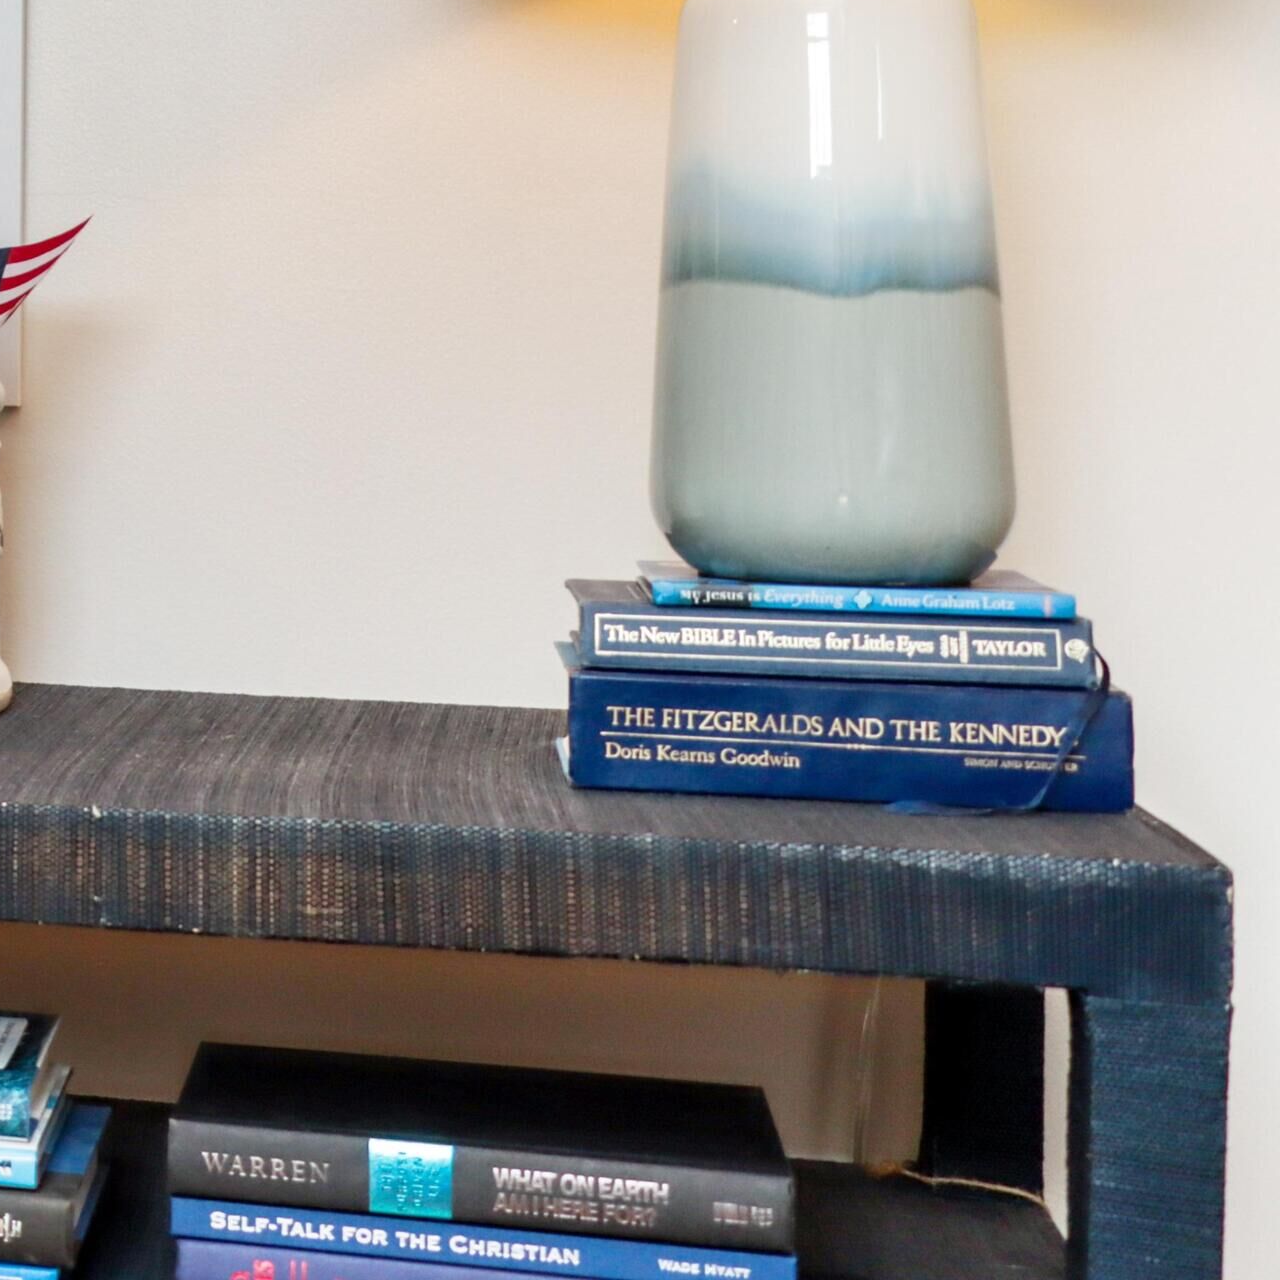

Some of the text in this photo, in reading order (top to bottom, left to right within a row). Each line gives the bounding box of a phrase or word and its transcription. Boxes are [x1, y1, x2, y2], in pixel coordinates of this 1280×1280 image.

[763, 588, 844, 608] Everything
[881, 595, 919, 609] Anne
[922, 595, 980, 610] Graham
[983, 596, 1016, 610] Lotz
[604, 624, 639, 643] The
[640, 626, 681, 645] New
[681, 628, 737, 647] BIBLE
[739, 630, 758, 647] In
[758, 630, 820, 650] Pictures
[825, 632, 851, 650] for
[851, 633, 894, 652] Little
[896, 635, 935, 658] Eyes
[972, 639, 1047, 657] TAYLOR
[606, 705, 1079, 747] THE FITZGERALDS AND THE KENNEDY
[604, 741, 801, 768] Doris Kearns Goodwin
[964, 757, 999, 768] SIMON
[1000, 759, 1023, 769] AND
[200, 1151, 331, 1184] WARREN
[492, 1167, 670, 1206] WHAT ON EARTH
[492, 1192, 531, 1215] AM
[543, 1198, 599, 1222] HERE
[602, 1203, 659, 1228] FOR?
[209, 1210, 581, 1267] SELF-TALK FOR THE CHRISTIAN
[657, 1258, 751, 1280] WADE HYATT
